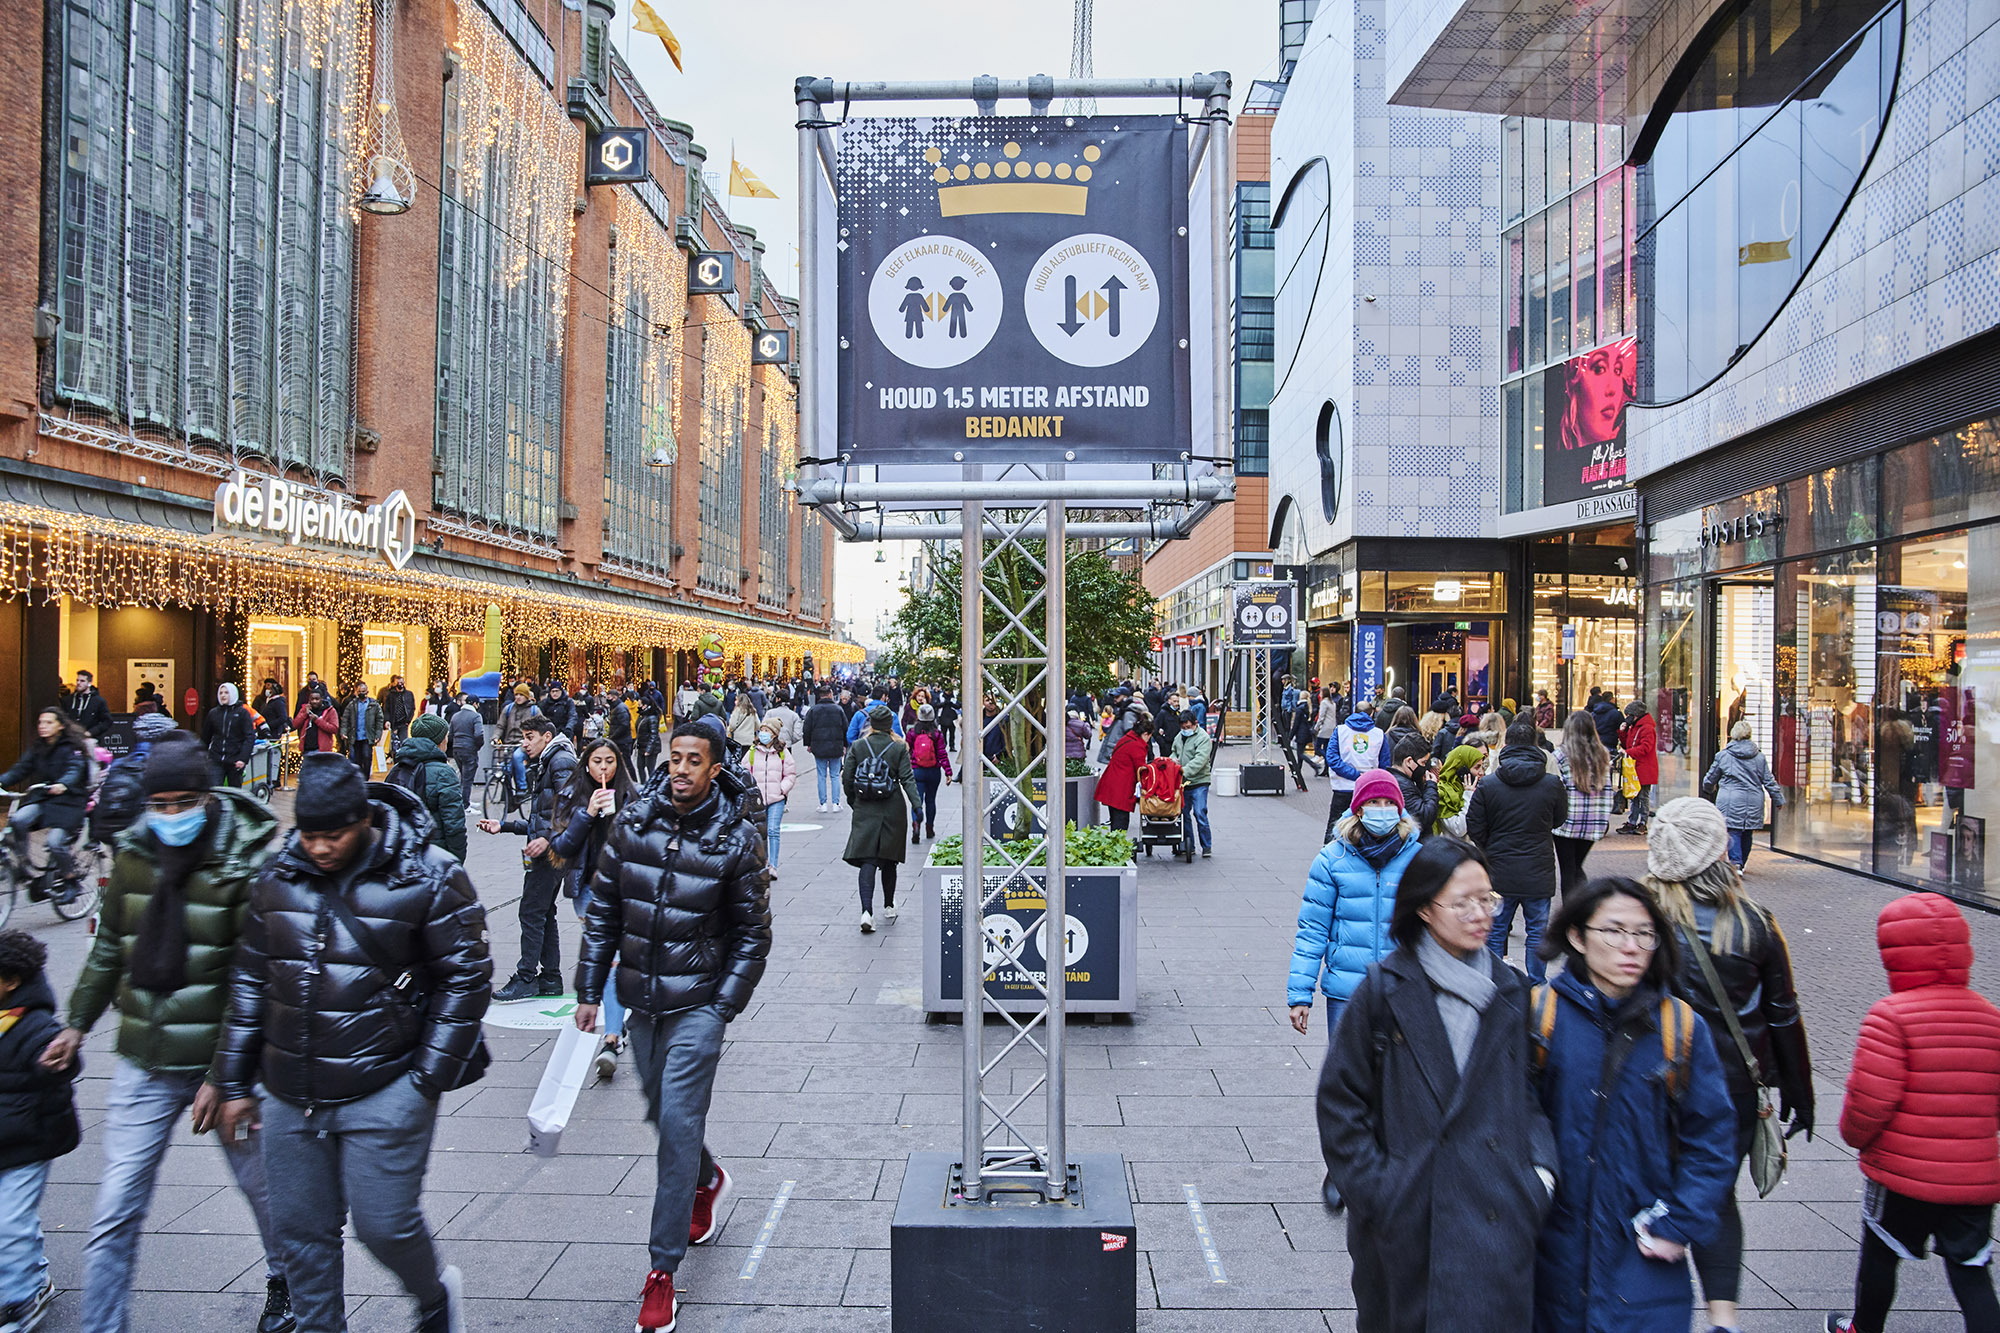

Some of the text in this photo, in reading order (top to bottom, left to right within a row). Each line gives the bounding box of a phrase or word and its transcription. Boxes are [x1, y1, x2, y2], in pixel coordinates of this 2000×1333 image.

[885, 244, 987, 279] GEEF ELKAAR DE RUIMTE
[1034, 242, 1150, 292] HOUD ALSTUBLIEFT RECHTS AAN
[880, 386, 1149, 409] HOUD 1,5 METER AFSTAND
[966, 415, 1064, 438] BEDANKT
[1581, 461, 1608, 484] PLASTIC
[1608, 457, 1627, 478] HEAR
[223, 470, 383, 546] de Bijenkorf
[1577, 502, 1590, 518] DE
[1700, 511, 1764, 548] COSTES
[1603, 587, 1643, 605] JAC
[1364, 631, 1376, 704] CK&JONES
[1066, 972, 1090, 982] TAND
[1101, 1232, 1127, 1244] SUPPORT
[1103, 1241, 1125, 1251] MARKT
